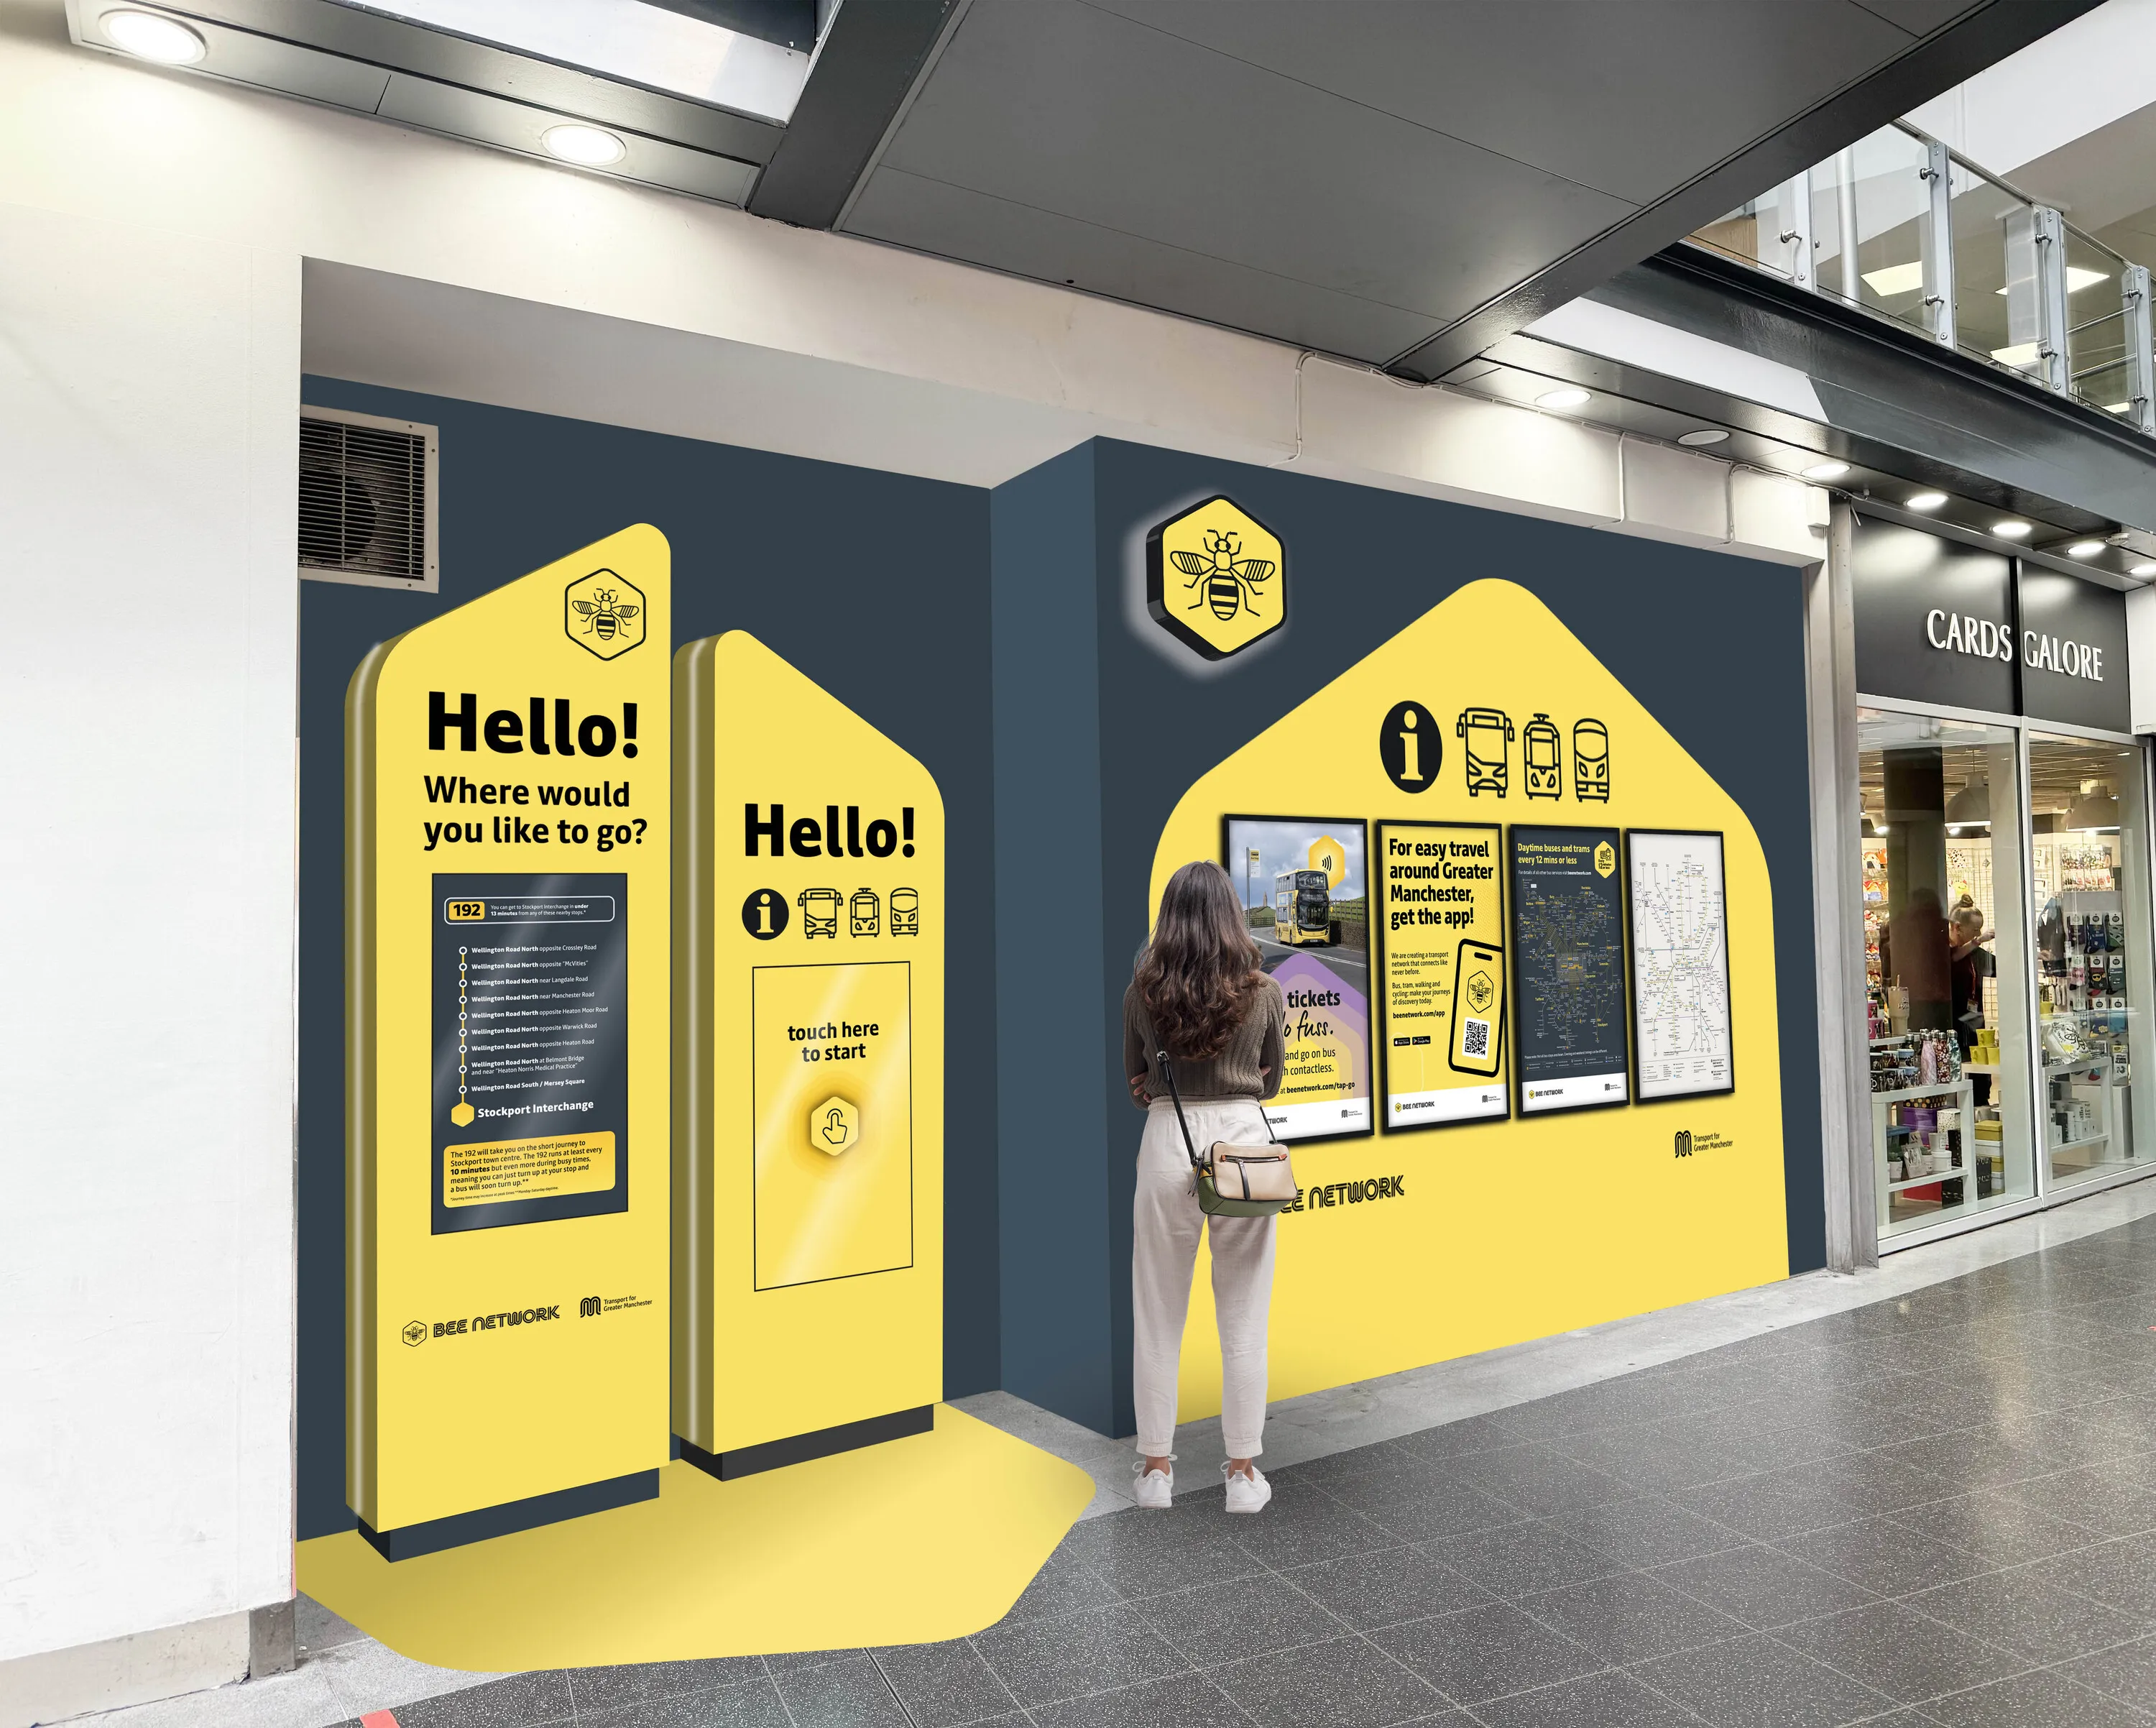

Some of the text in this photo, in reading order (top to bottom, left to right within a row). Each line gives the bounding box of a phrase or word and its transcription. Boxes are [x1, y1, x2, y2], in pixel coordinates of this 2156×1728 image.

[1927, 609, 2104, 681] CARDS GALORE
[428, 691, 638, 758] Hello!
[423, 775, 630, 807] Where would
[423, 816, 648, 852] you like to go?
[745, 803, 915, 858] Hello!
[1389, 837, 1489, 861] For easy travel
[1517, 842, 1543, 854] Daytime
[1561, 844, 1572, 852] and
[1518, 857, 1535, 866] every
[1389, 862, 1493, 879] around Greater
[1391, 884, 1474, 904] Manchester,
[453, 904, 480, 916] 192
[1391, 906, 1474, 931] get the app!
[1286, 989, 1340, 1008] tickets
[1393, 1009, 1445, 1019] beenetwork.com/app
[787, 1021, 879, 1042] touch here
[1296, 1009, 1333, 1042] fuss.
[801, 1043, 866, 1062] to start
[1285, 1047, 1336, 1062] and go on bus
[1290, 1062, 1334, 1075] contactless.
[1286, 1082, 1355, 1093] beenetwork.com/tap-go
[477, 1101, 594, 1118] Stockport Interchange
[554, 1141, 579, 1150] journey
[1694, 1134, 1713, 1142] Transport
[450, 1158, 482, 1167] Stockport
[460, 1166, 490, 1175] minutes
[1309, 1175, 1404, 1210] NETWORK
[603, 1296, 628, 1305] Transport
[623, 1300, 653, 1308] Manchester
[433, 1305, 560, 1338] BEE NETWORK
